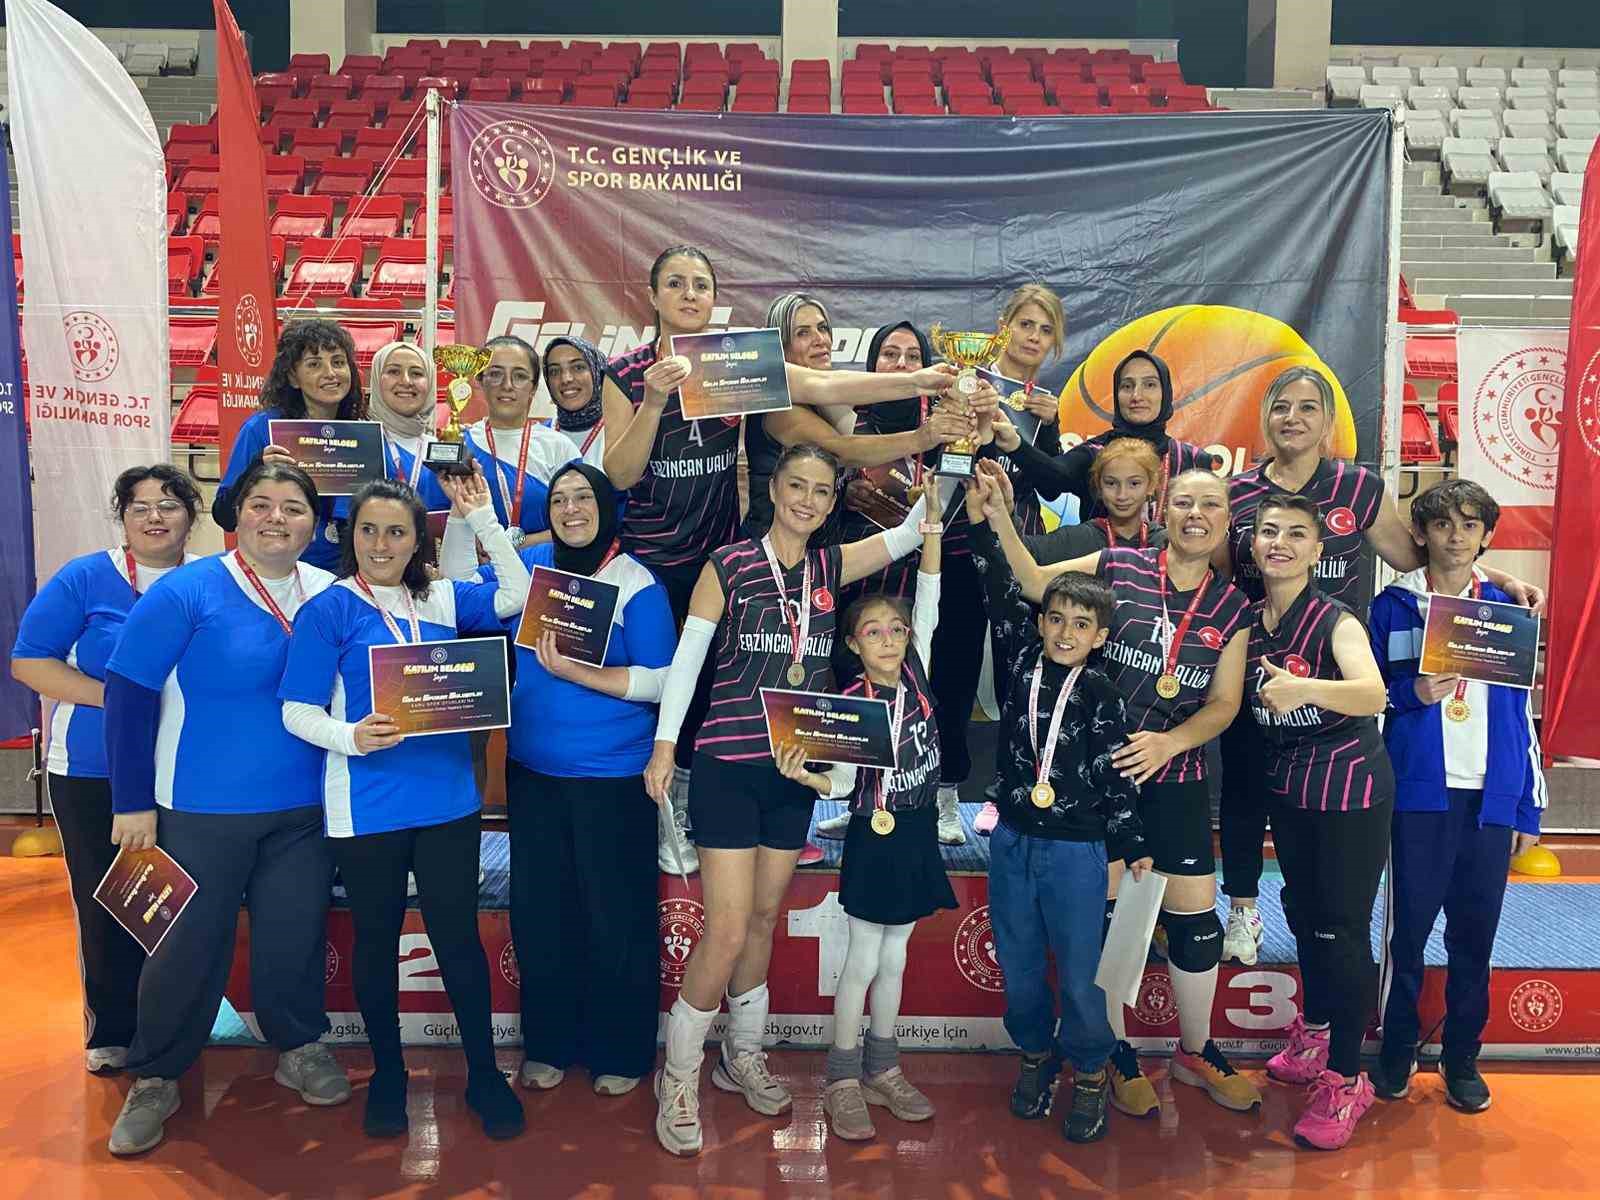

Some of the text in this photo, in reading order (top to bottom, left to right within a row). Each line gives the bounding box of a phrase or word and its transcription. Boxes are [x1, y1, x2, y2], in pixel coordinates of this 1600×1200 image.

[568, 145, 742, 170] T.C. GENÇLİK VE
[567, 171, 742, 191] SPOR BAKANLIĞI
[688, 420, 704, 447] 4
[787, 891, 851, 996] 1
[398, 933, 447, 992] 2
[1224, 971, 1298, 1030] 3
[896, 1024, 940, 1040] ürkiye
